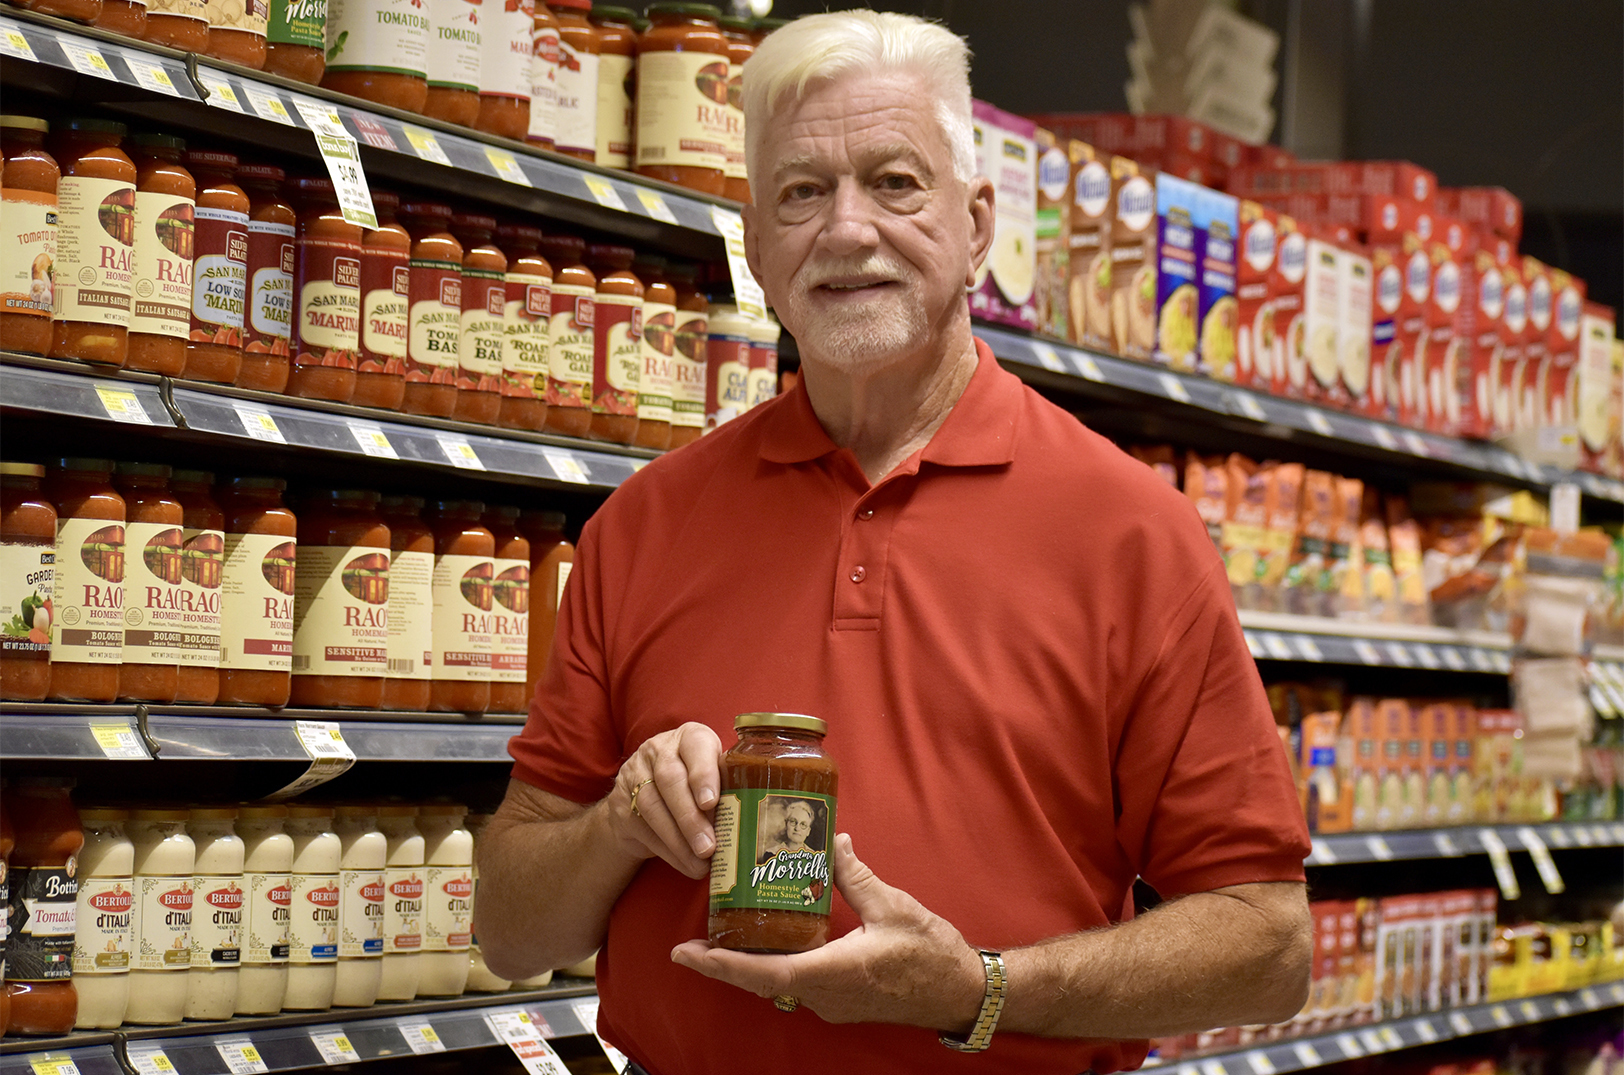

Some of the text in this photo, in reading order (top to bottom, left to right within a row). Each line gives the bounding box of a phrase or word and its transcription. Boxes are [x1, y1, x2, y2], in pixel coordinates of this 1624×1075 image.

[376, 10, 419, 28] TOMATO
[291, 26, 308, 34] Pasta
[437, 26, 476, 44] TOMATO
[363, 133, 398, 151] ITEM!
[17, 230, 49, 245] TOMATO
[202, 266, 229, 279] SAN
[337, 264, 359, 277] SILVER
[207, 281, 232, 296] LOW
[259, 279, 284, 291] SAN
[79, 293, 109, 304] ITALIAN
[265, 293, 285, 307] LOW
[307, 295, 337, 308] SAN
[136, 304, 166, 315] ITALIAN
[373, 304, 397, 315] SAN
[418, 313, 443, 324] SAN
[82, 584, 123, 609] RAO
[181, 589, 221, 614] RAO
[2, 641, 11, 650] NET
[12, 641, 19, 650] WT
[327, 648, 375, 656] SENSITIVE
[778, 850, 813, 862] Grandma
[759, 882, 800, 893] Homestyle
[780, 891, 801, 899] Sauce
